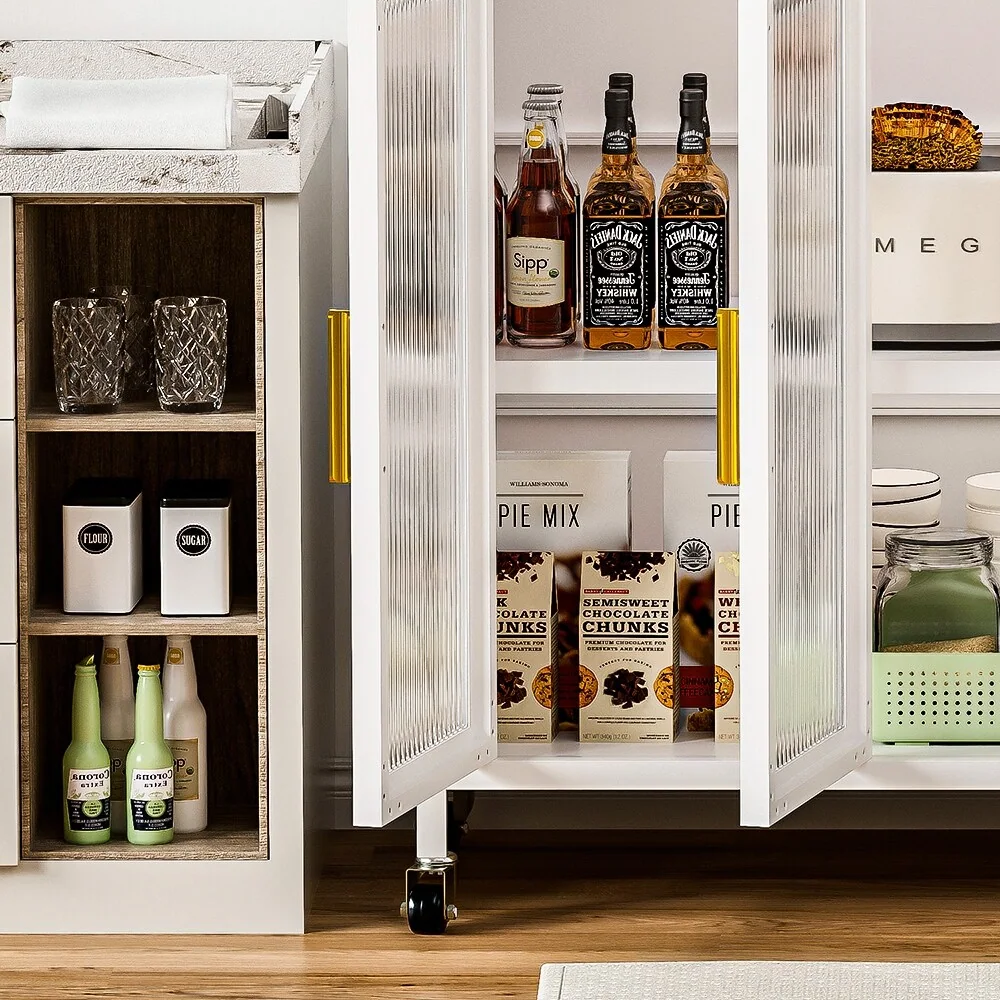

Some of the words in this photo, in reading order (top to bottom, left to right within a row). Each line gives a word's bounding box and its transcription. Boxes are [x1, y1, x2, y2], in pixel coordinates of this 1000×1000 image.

[875, 237, 979, 253] MEG
[514, 252, 548, 274] Sipp
[498, 504, 530, 528] PIE
[544, 504, 580, 528] MIX
[712, 504, 740, 528] PIE
[84, 533, 108, 544] FLOUR
[182, 534, 206, 546] SUGAR
[583, 598, 670, 608] SEMISWEET
[497, 610, 547, 618] OLATE
[582, 610, 669, 618] CHOCOLATE
[496, 621, 547, 634] UNKS
[582, 621, 669, 634] CHUNKS
